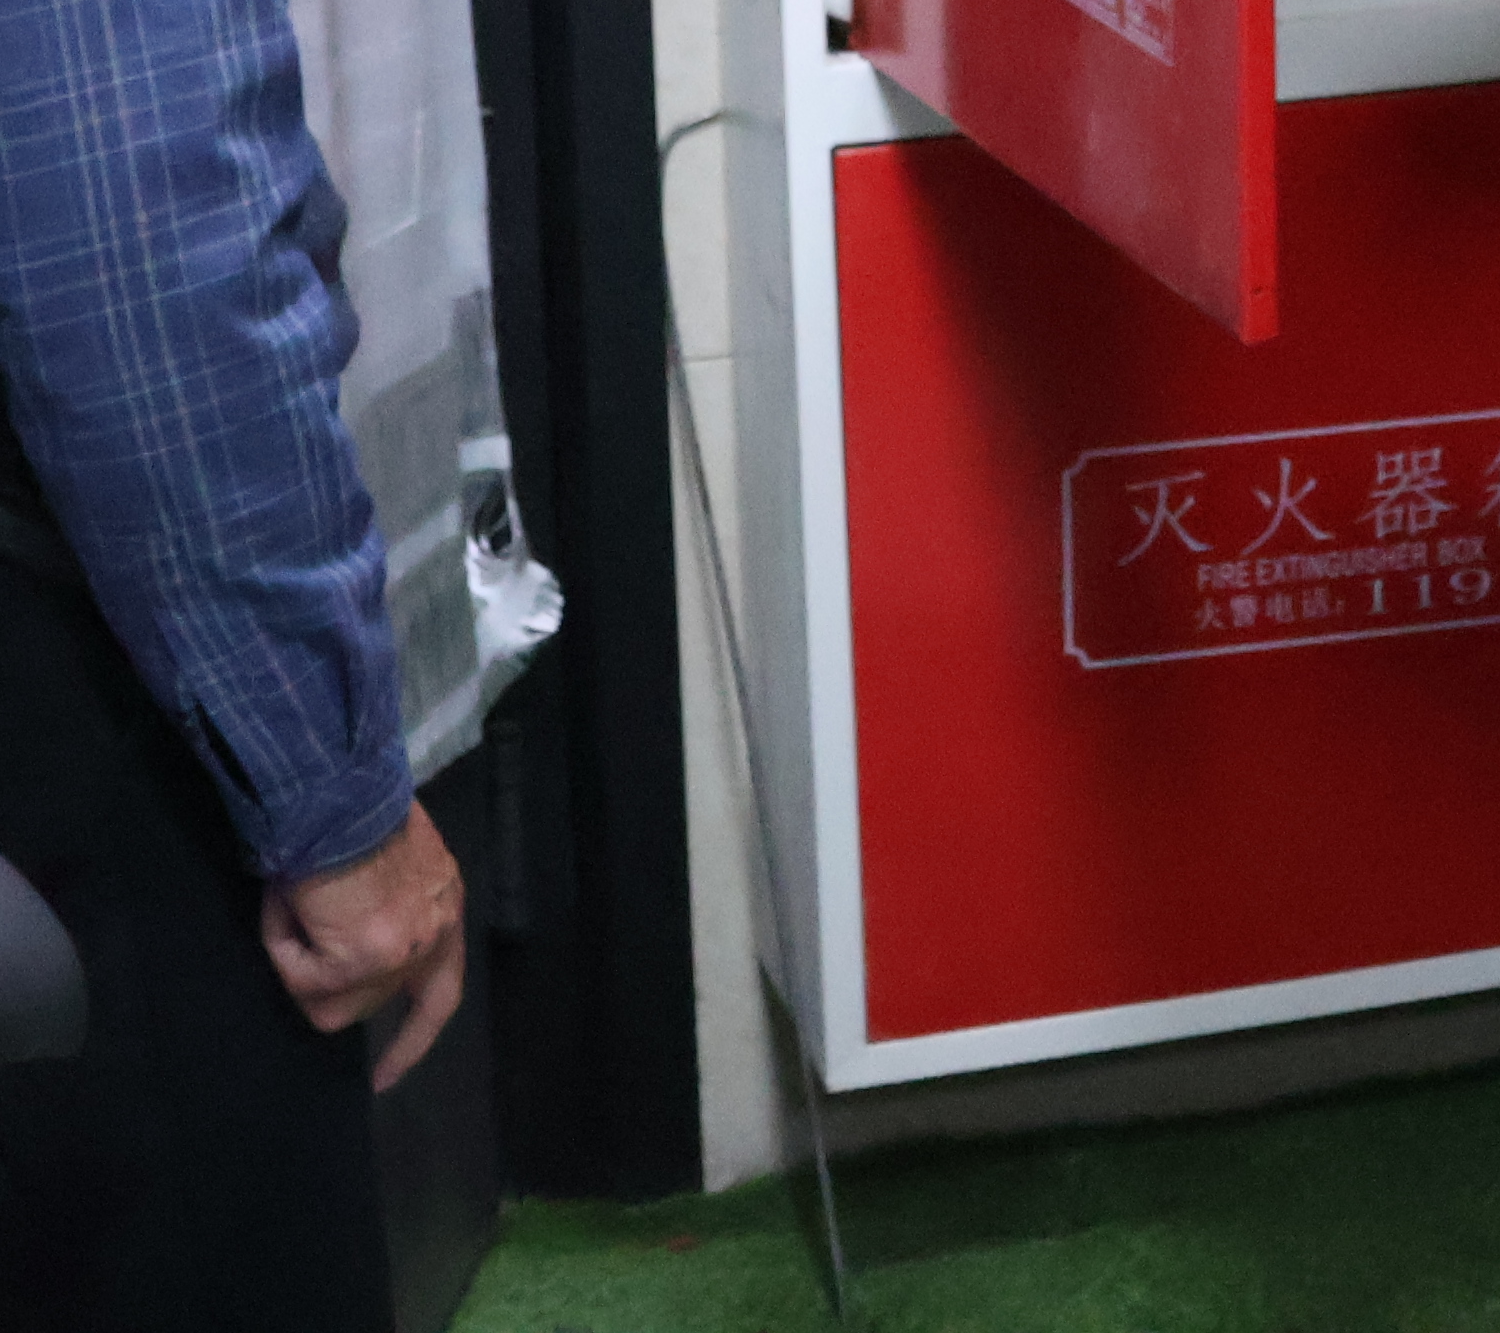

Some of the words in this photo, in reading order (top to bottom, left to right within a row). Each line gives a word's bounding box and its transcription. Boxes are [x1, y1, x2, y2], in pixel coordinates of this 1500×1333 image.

[1198, 563, 1250, 591] FIRE
[1437, 536, 1487, 566] BOX
[1364, 568, 1493, 614] 119
